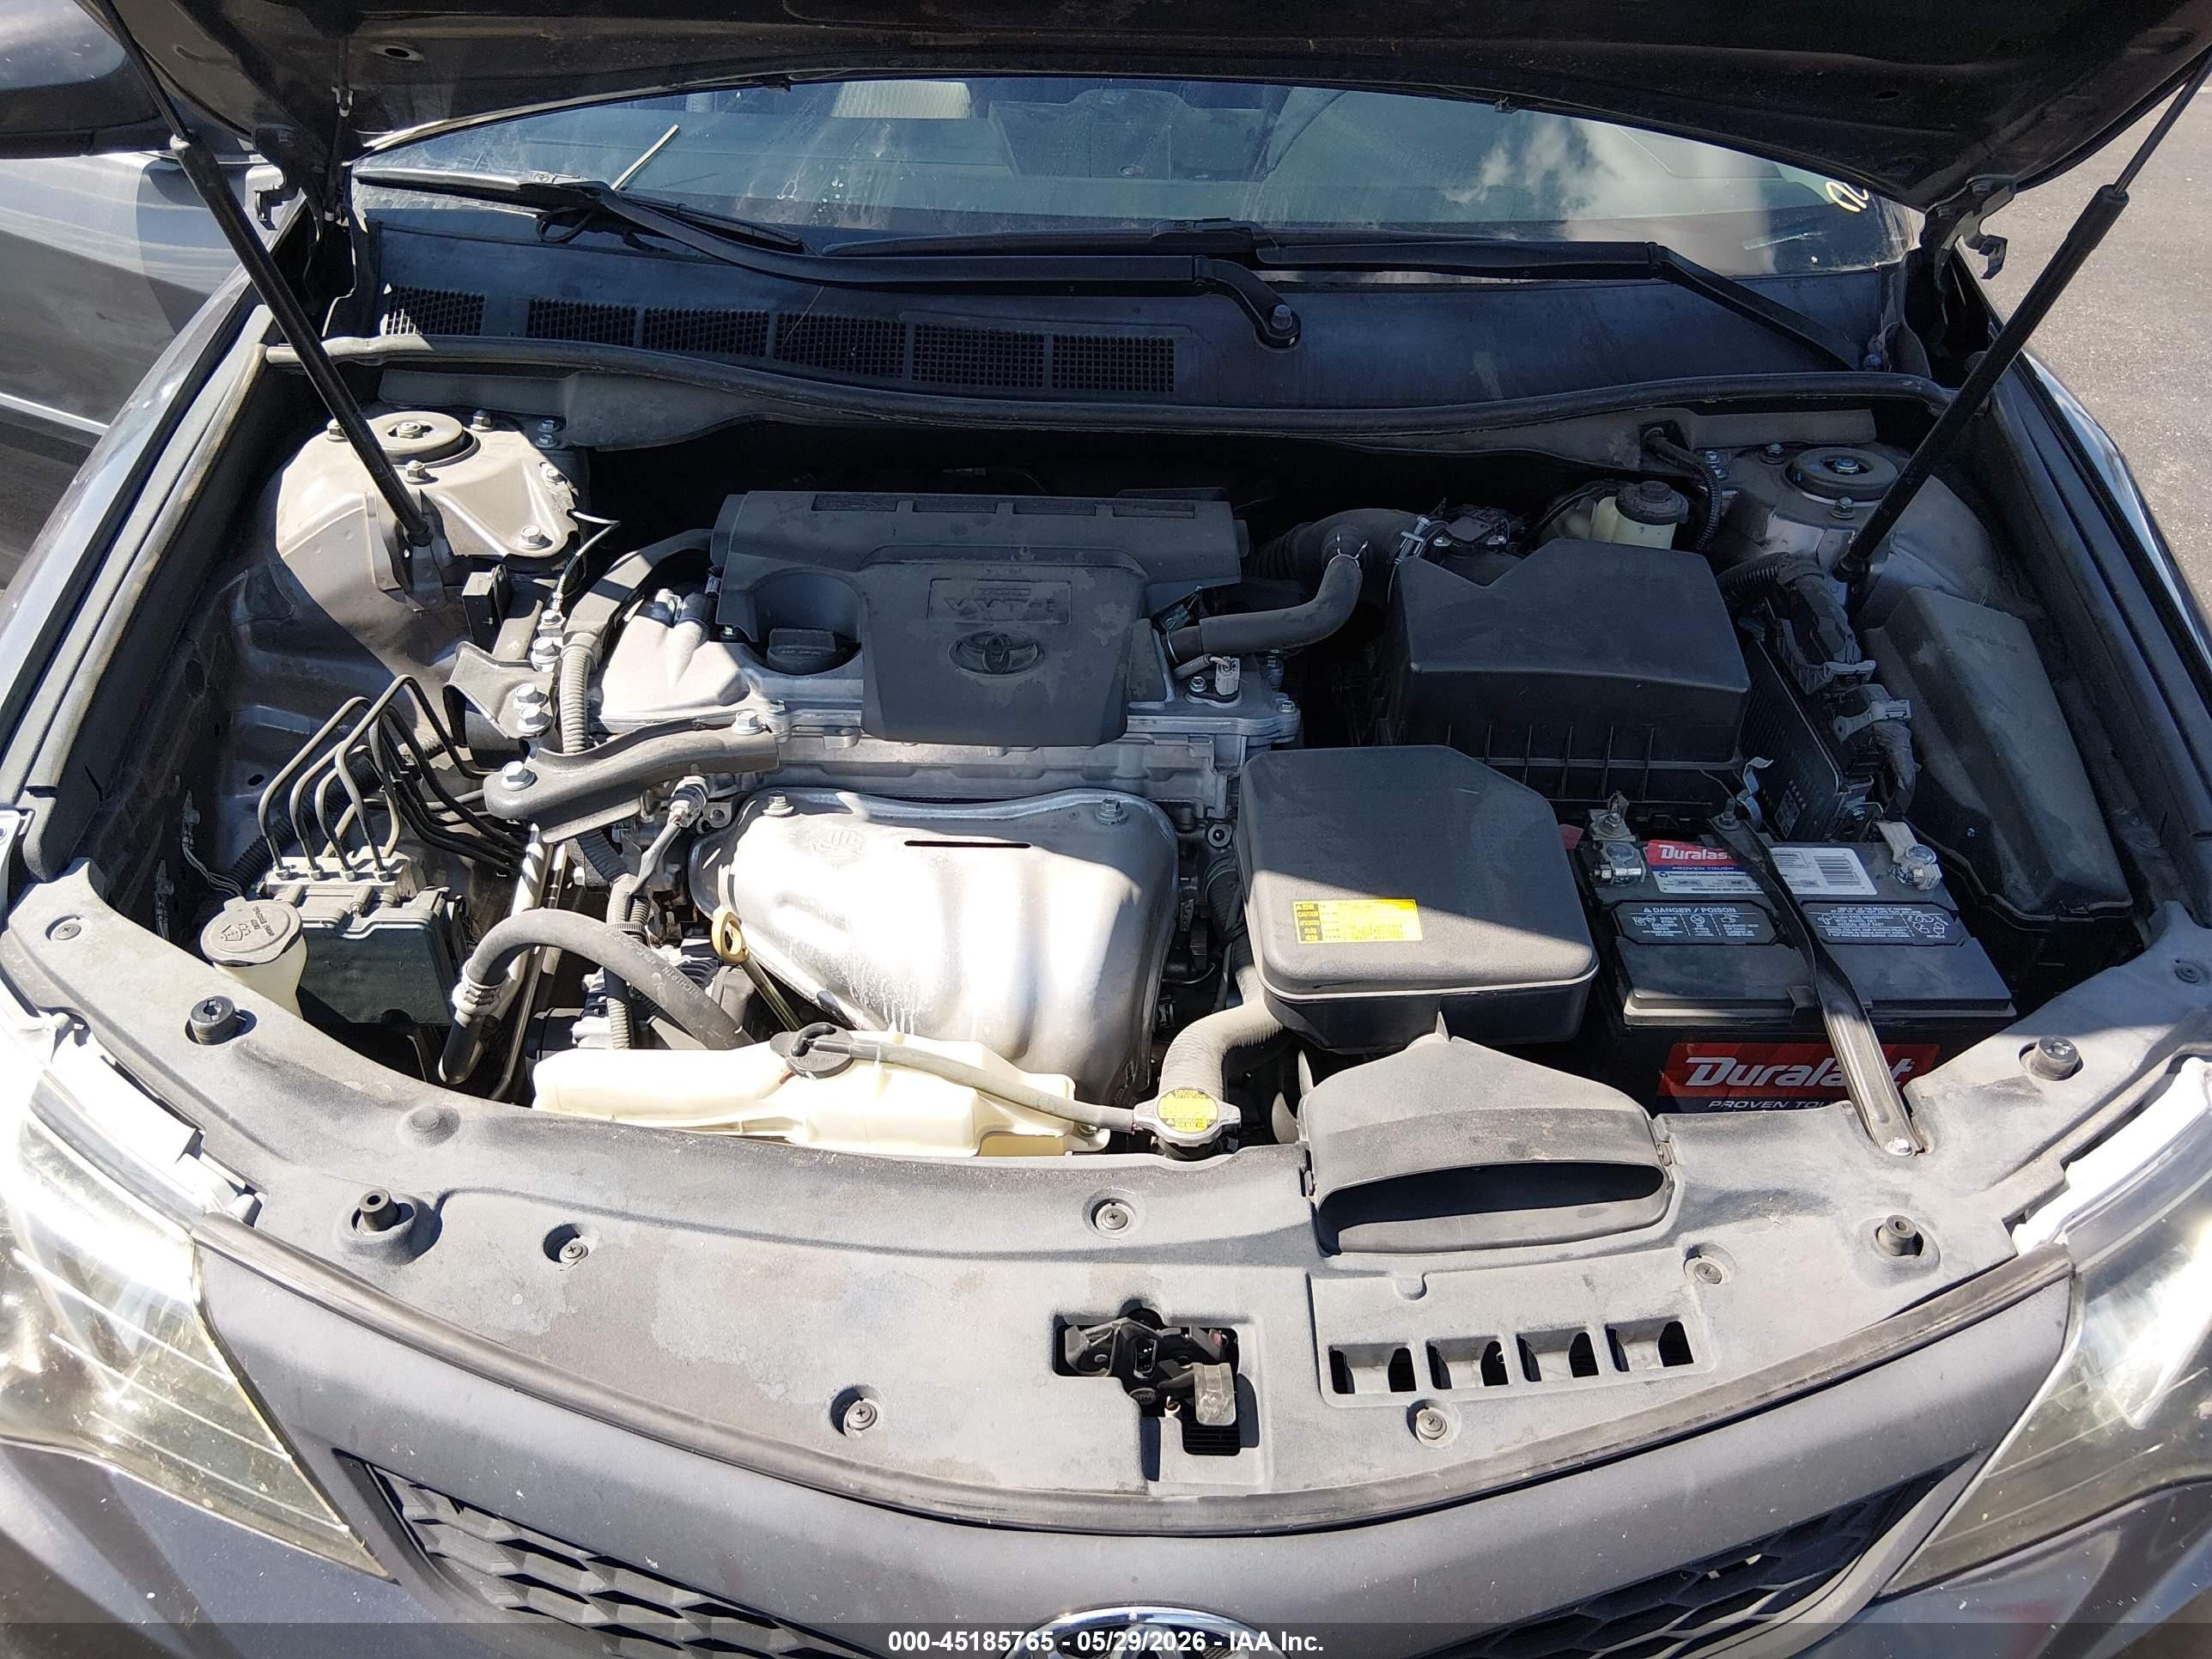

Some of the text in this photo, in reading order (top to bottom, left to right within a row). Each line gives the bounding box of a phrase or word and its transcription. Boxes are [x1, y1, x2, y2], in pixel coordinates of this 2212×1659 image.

[1658, 844, 1733, 860] Duralas
[1685, 1056, 1912, 1086] Duralat
[1708, 1100, 1790, 1109] PROVEN
